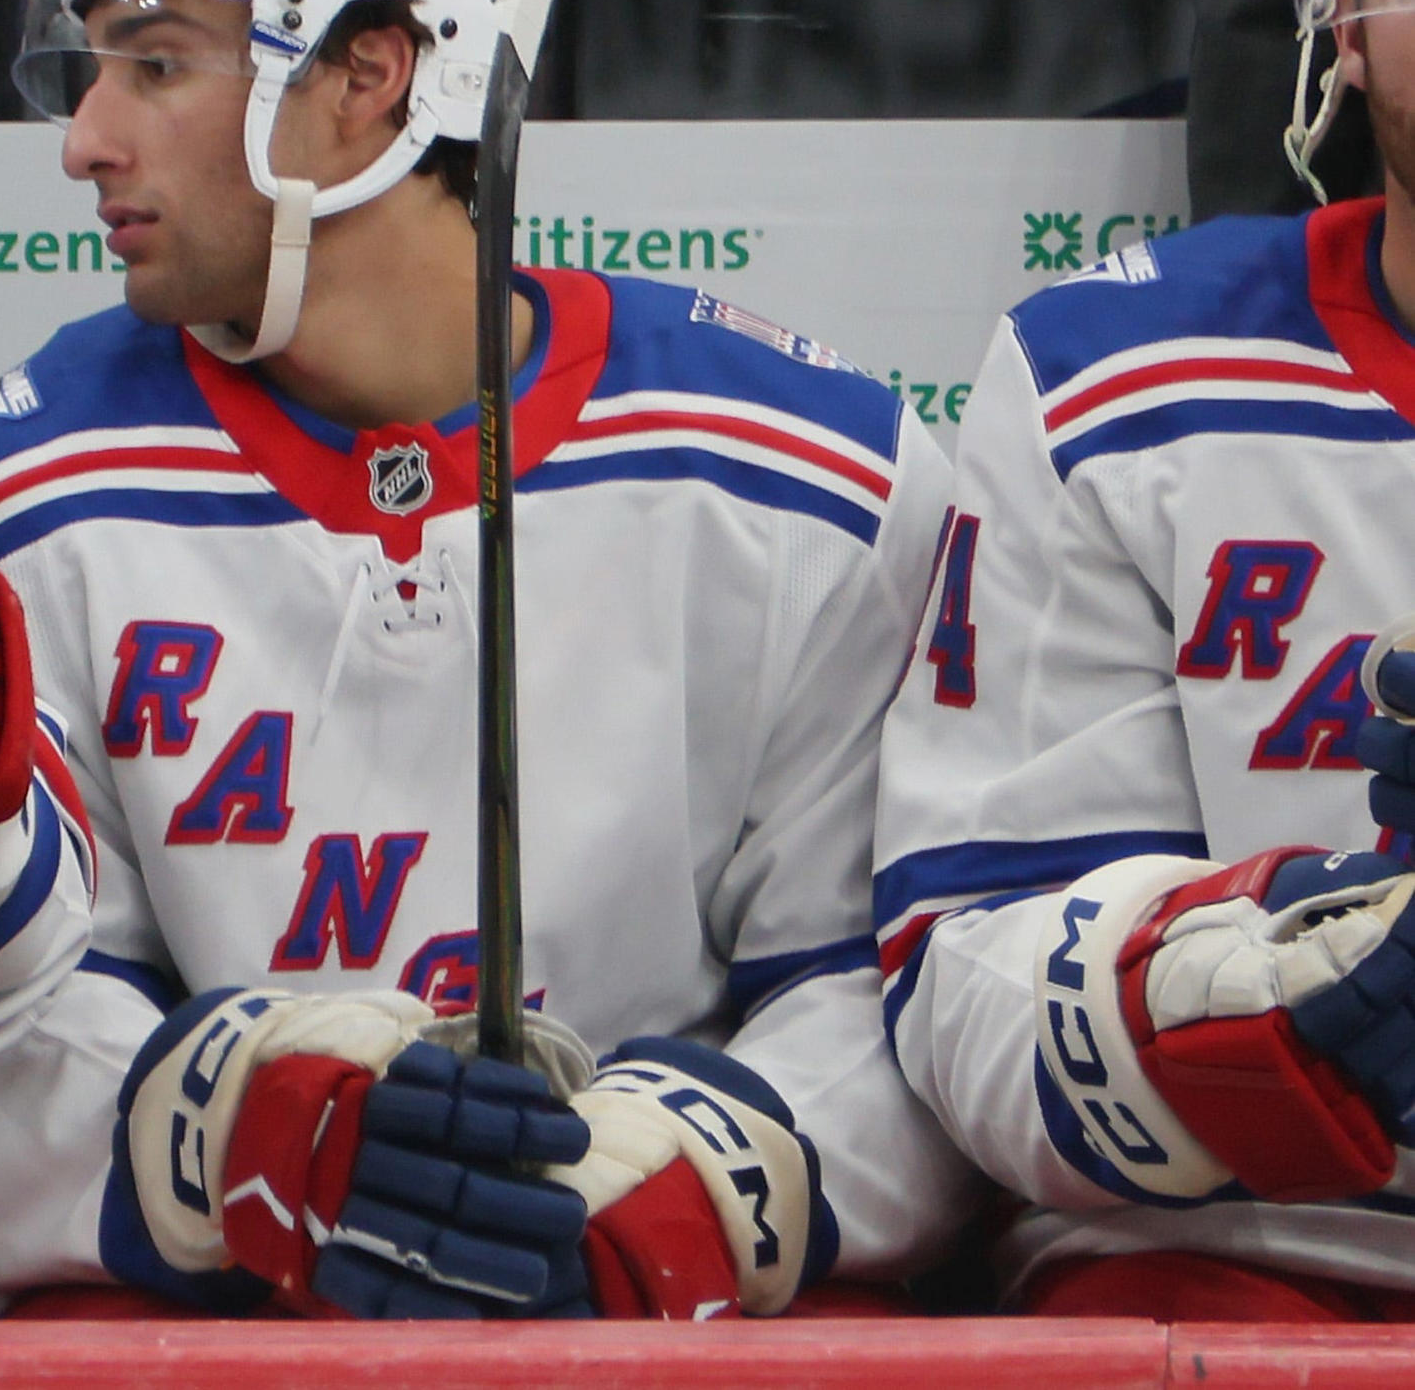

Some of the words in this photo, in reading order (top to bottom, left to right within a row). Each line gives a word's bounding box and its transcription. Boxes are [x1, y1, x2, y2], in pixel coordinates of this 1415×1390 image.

[514, 216, 749, 270] itizens
[916, 507, 980, 709] 4
[103, 620, 511, 1020] RANG
[1047, 897, 1169, 1166] CCM
[592, 1068, 779, 1269] CCM
